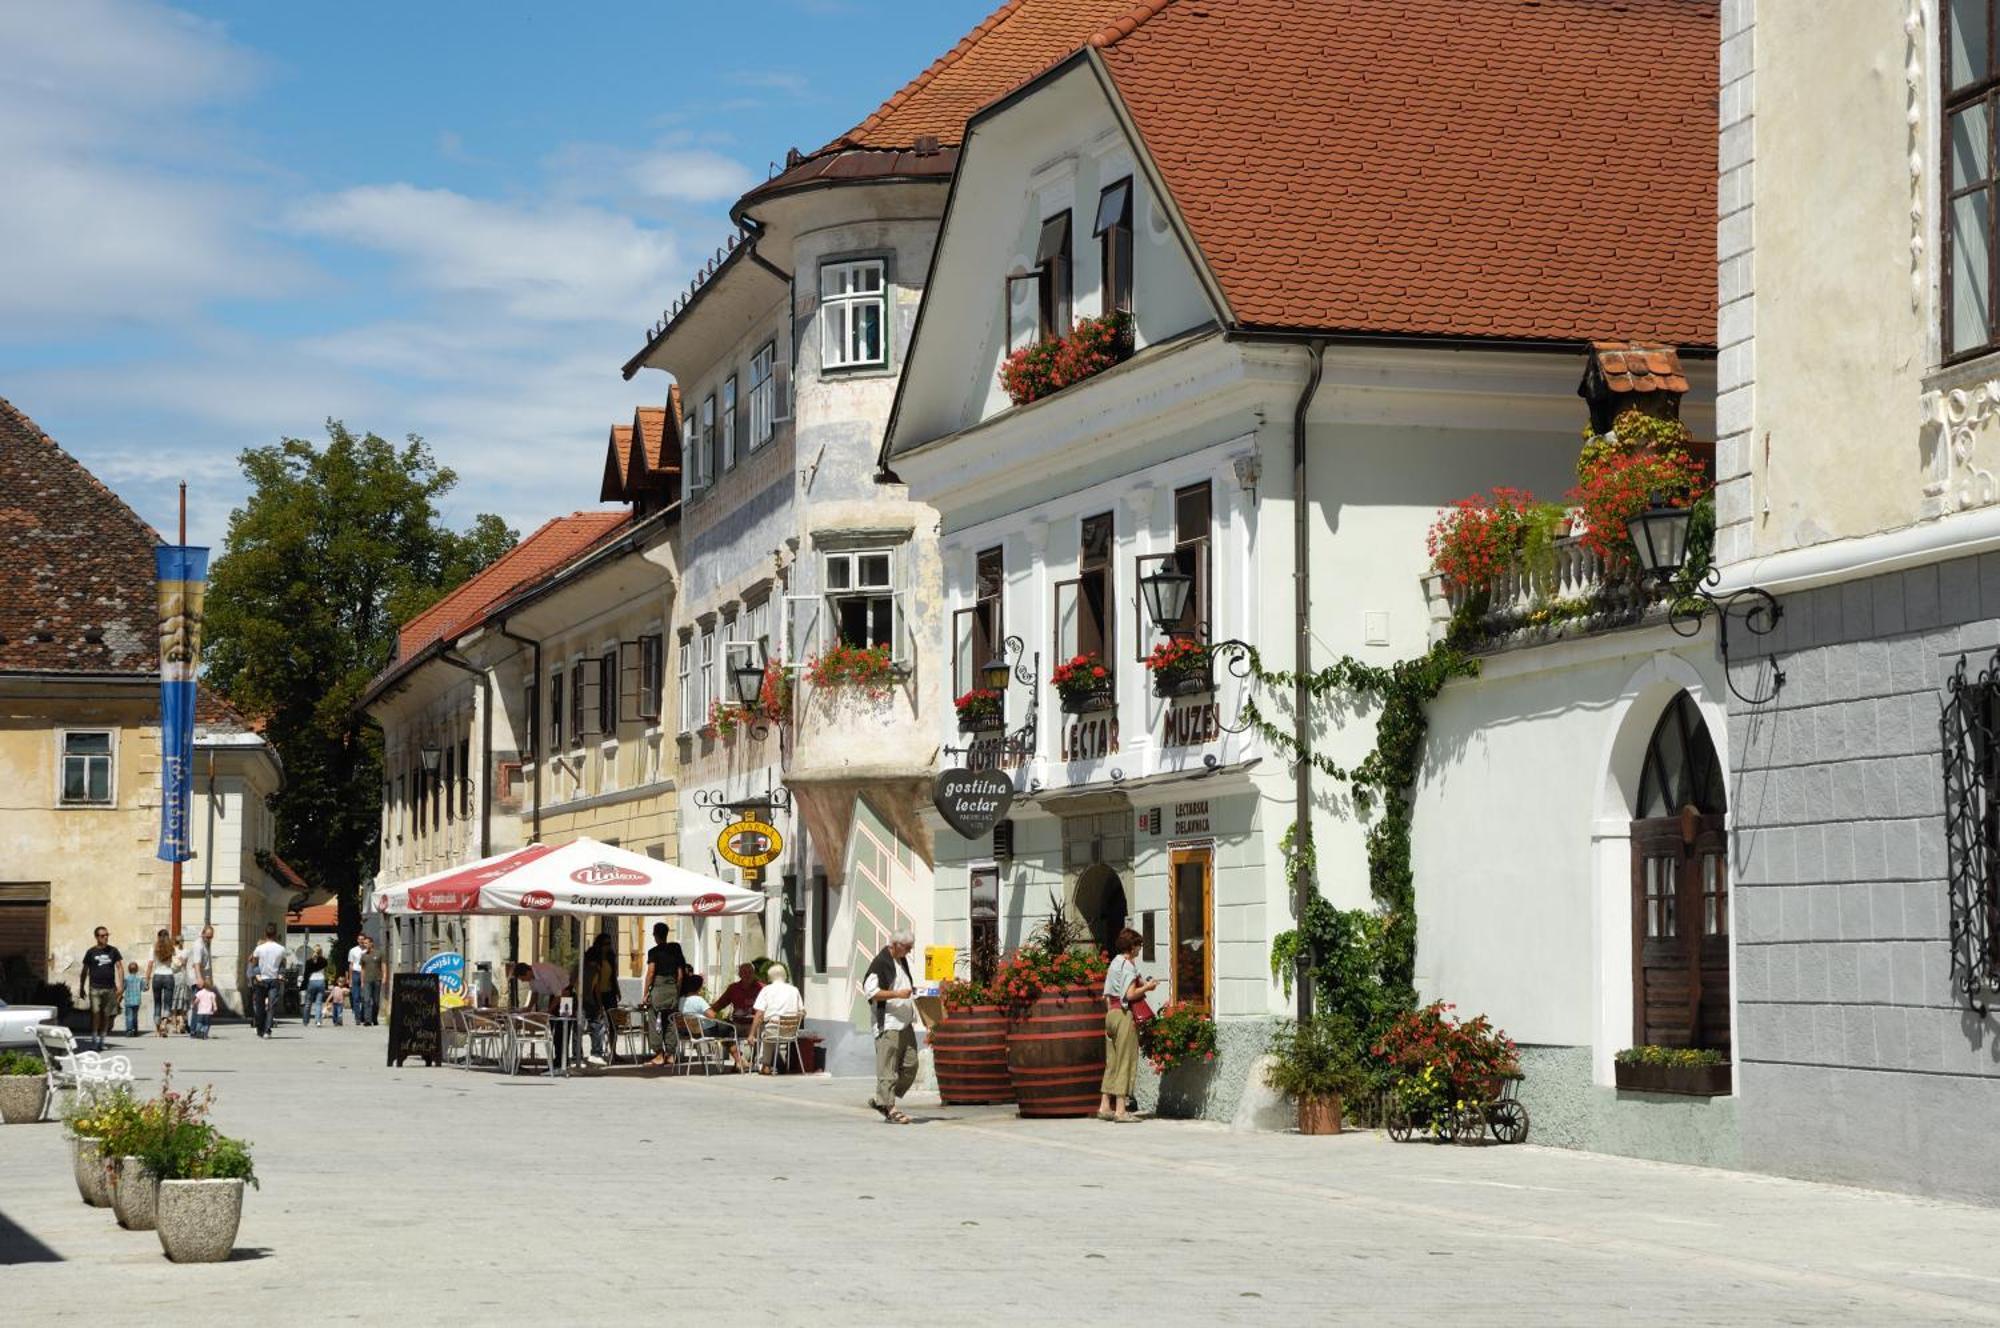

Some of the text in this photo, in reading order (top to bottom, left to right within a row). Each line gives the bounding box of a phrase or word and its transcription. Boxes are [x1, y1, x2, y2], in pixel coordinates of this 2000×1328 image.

[1061, 716, 1120, 763] LECTAR
[1163, 702, 1221, 749] MUZEJ
[944, 779, 1007, 798] gostilna
[955, 797, 998, 812] lectar
[1175, 801, 1209, 818] LECTARSKA
[1175, 819, 1210, 835] DELAVNICA
[577, 870, 645, 885] Union
[571, 894, 678, 908] Za popoln užitek
